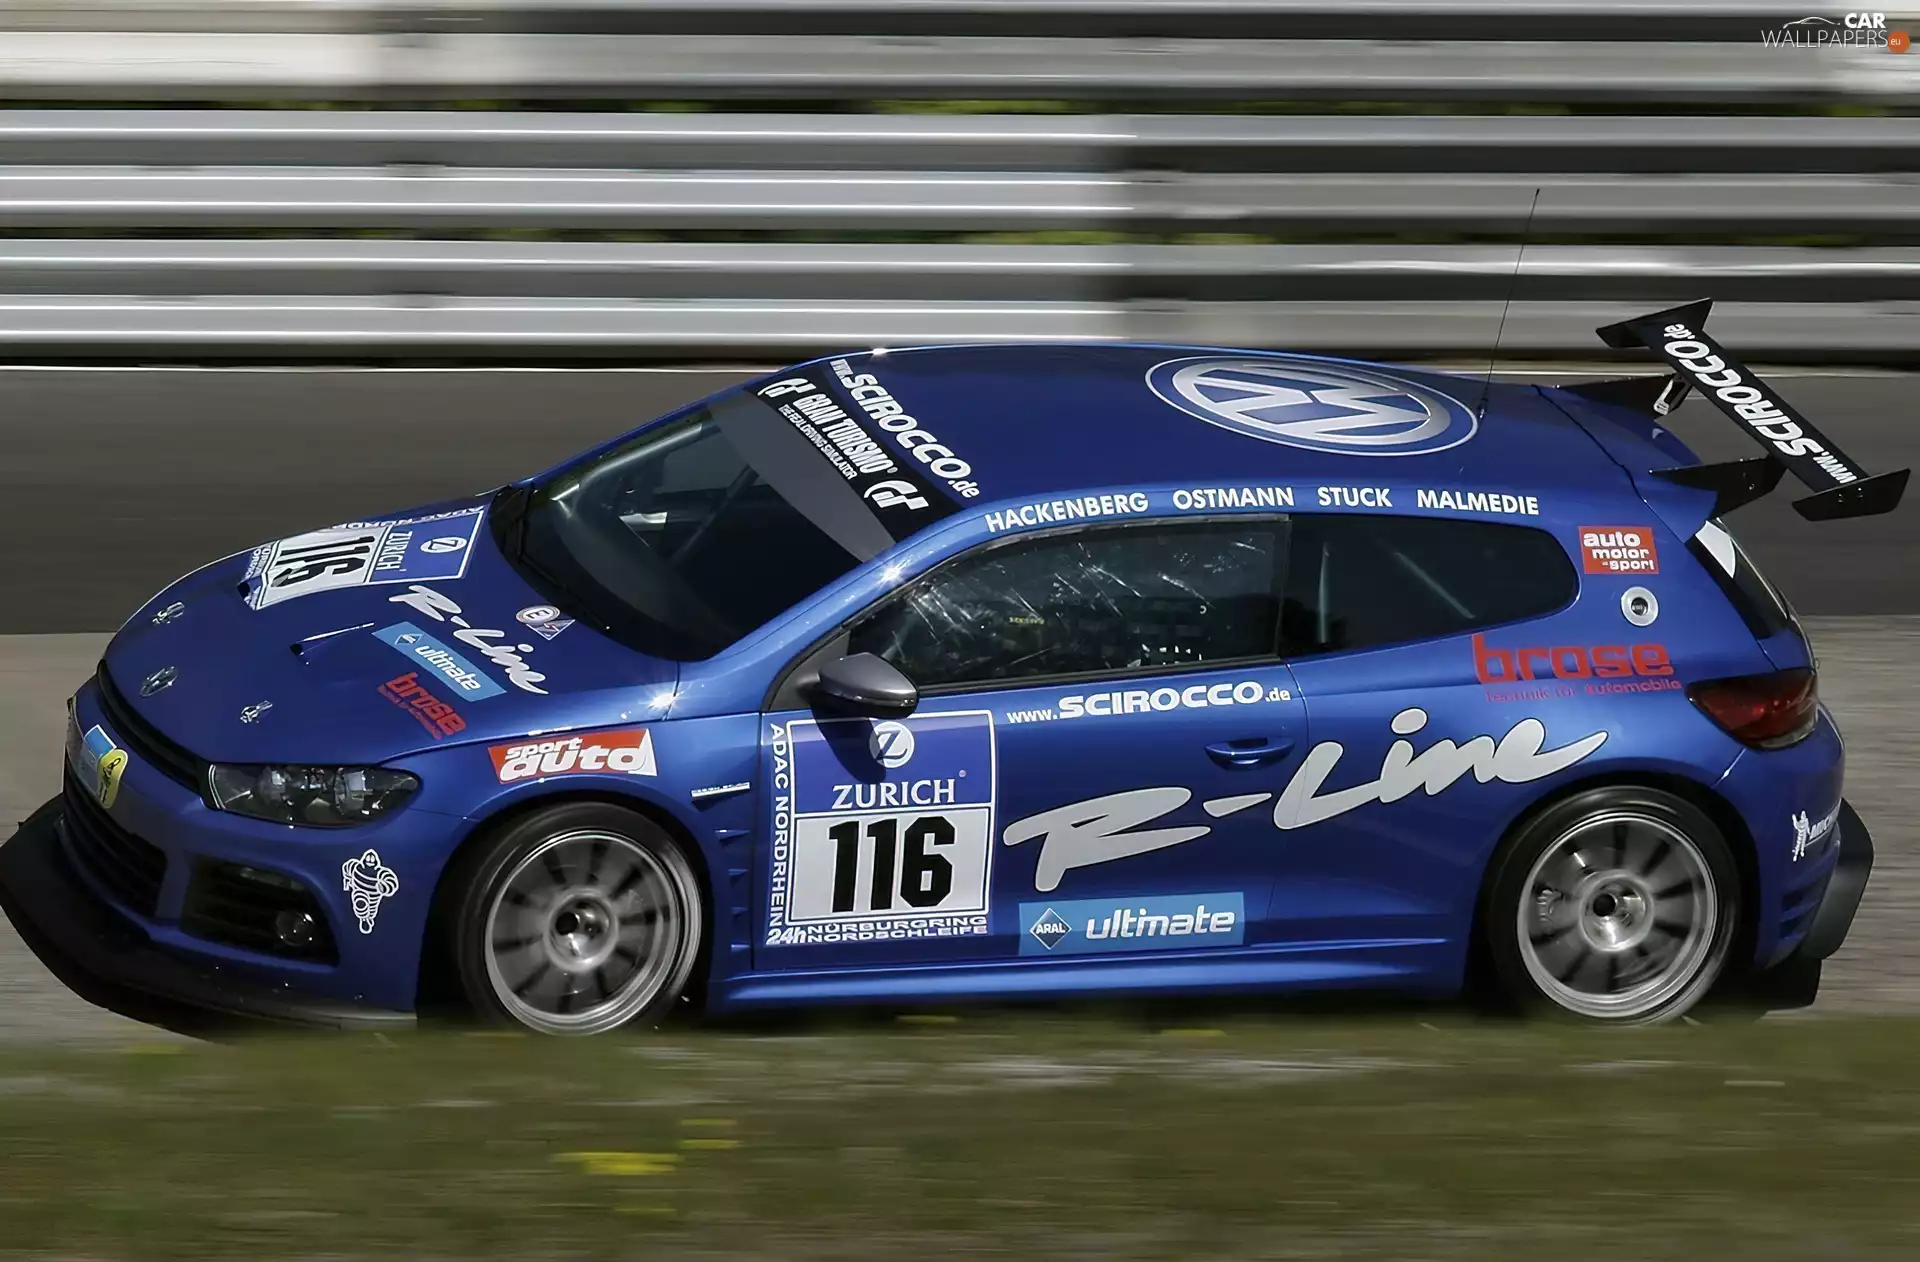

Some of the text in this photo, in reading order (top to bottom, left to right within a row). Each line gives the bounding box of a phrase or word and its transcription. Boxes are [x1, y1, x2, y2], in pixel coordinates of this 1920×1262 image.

[1664, 323, 1857, 484] www.SCIROCCO.de
[985, 487, 1539, 532] HACKENBERG OSTMANN STUCK MALMEDIE
[1583, 531, 1641, 547] auto
[1591, 547, 1649, 559] motor
[415, 645, 481, 691] ultimate
[1472, 632, 1674, 684] brose
[385, 672, 467, 736] brose
[1007, 681, 1291, 724] www.SCIROCCO.de
[505, 737, 583, 765] sport
[831, 778, 956, 810] ZURICH
[769, 723, 789, 928] ADAC NORDRHEIN
[829, 816, 956, 913] 116
[766, 927, 807, 945] 24h
[807, 926, 988, 943] NORDSCHLEIFE
[1035, 904, 1235, 940] ARAL ultimate
